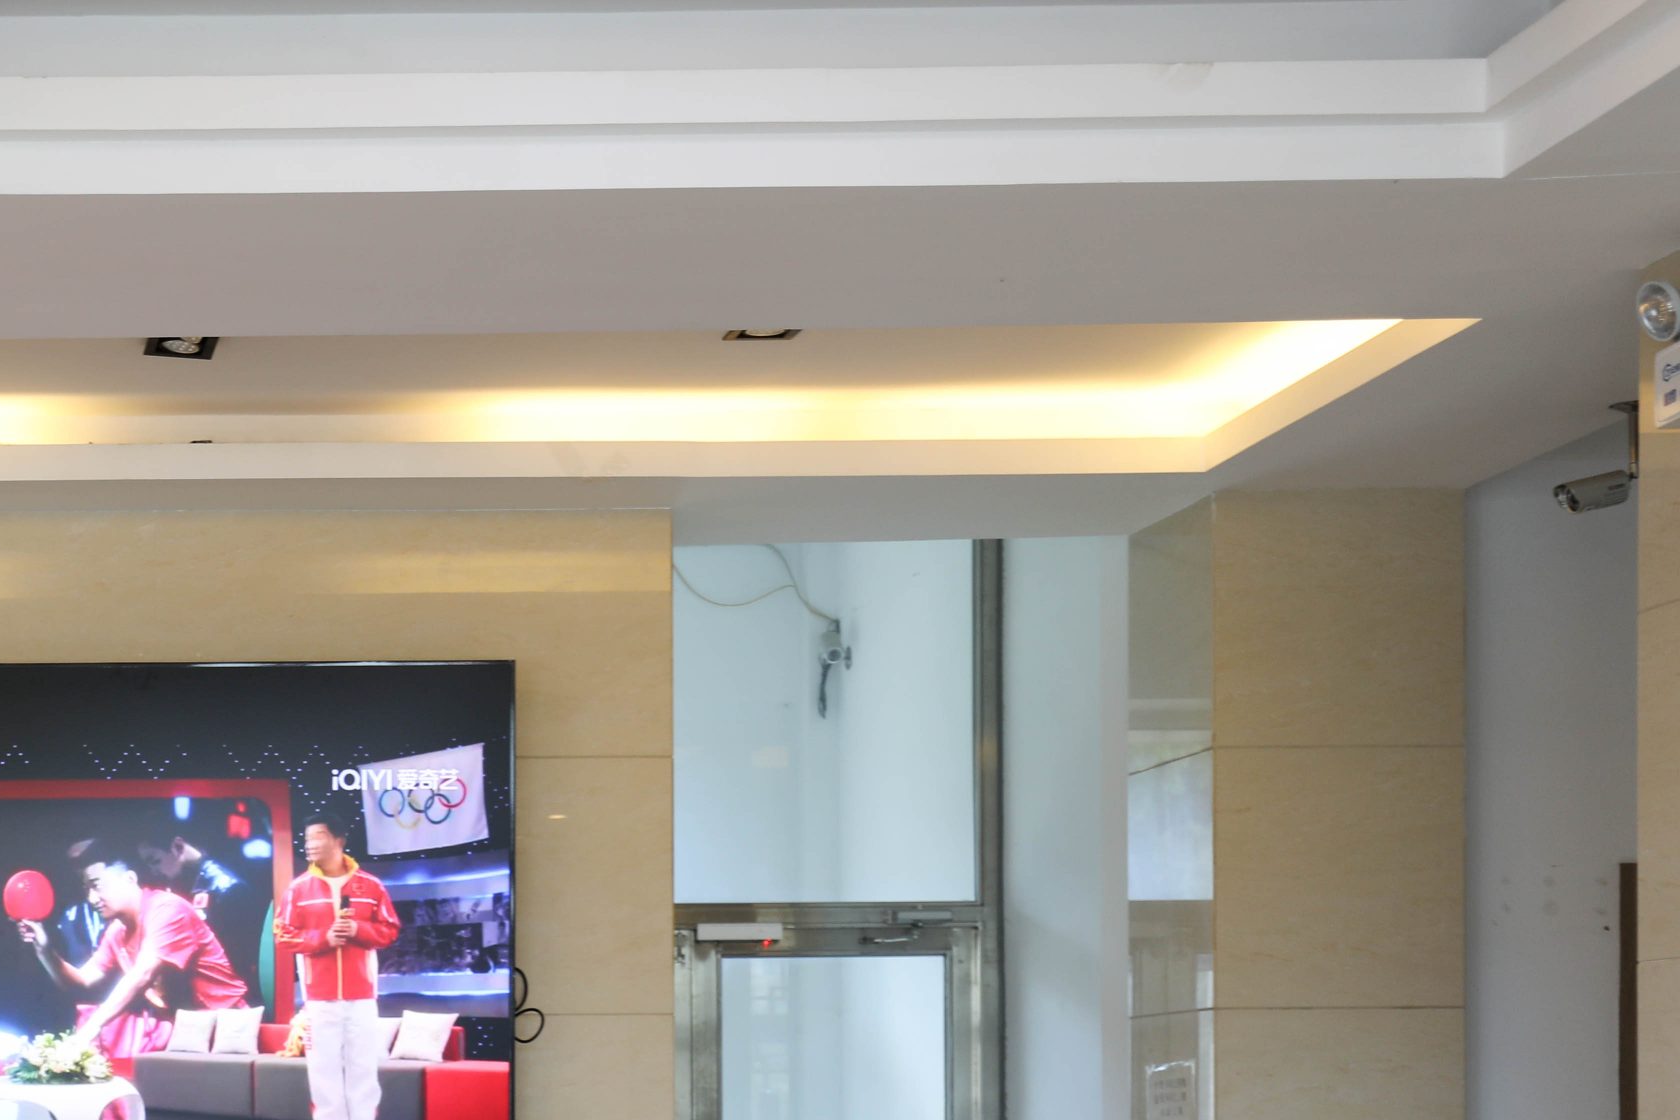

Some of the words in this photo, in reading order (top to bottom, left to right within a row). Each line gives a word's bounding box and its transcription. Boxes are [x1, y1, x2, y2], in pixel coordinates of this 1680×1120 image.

[331, 769, 393, 791] iQIYI
[396, 769, 459, 791] 爱奇艺
